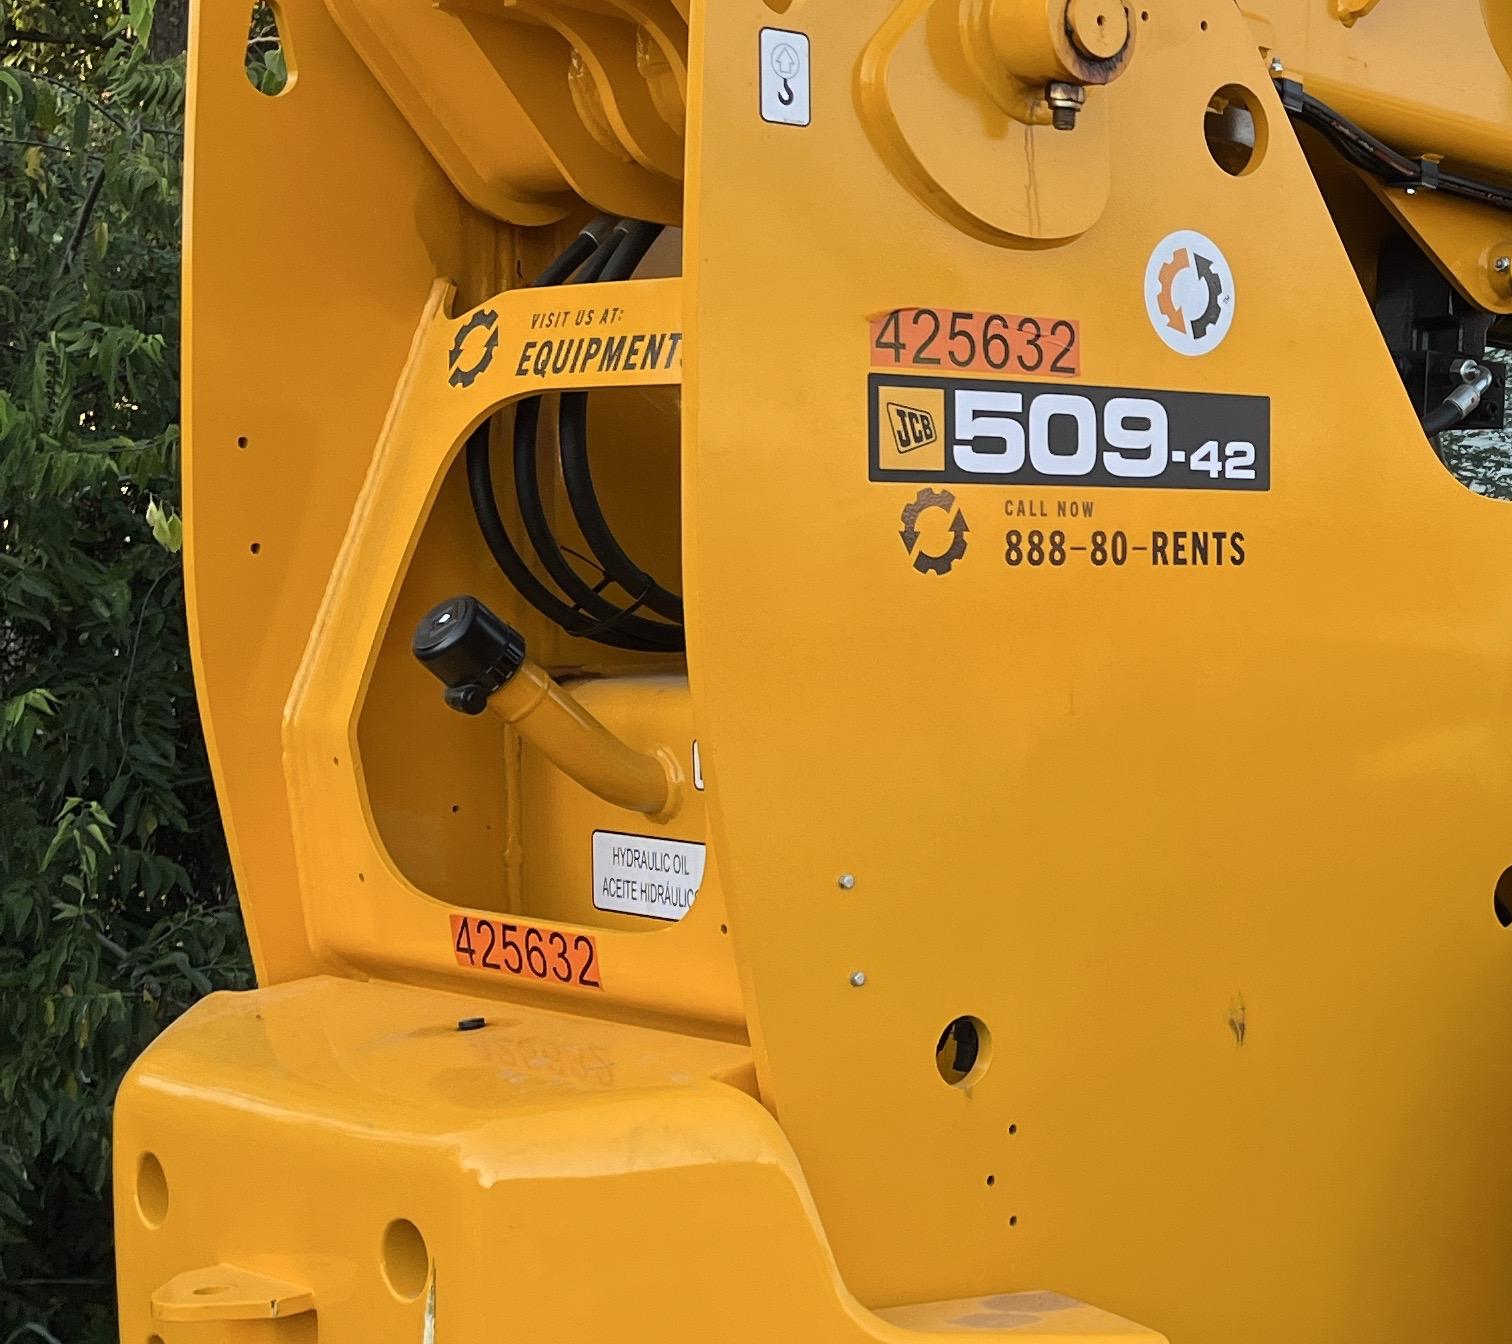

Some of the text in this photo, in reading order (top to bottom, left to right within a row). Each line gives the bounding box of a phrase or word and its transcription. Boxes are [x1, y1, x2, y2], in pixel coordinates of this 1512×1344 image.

[531, 307, 624, 329] VISIT US AT:
[515, 333, 682, 378] EQUIPMENT
[874, 308, 1077, 375] 425632
[897, 389, 1256, 480] JCB 509-42
[1004, 499, 1094, 518] CALL NOW
[1005, 529, 1246, 567] 888-80-RENTS
[612, 846, 690, 875] HYDRAULIC OIL
[602, 877, 699, 908] ACEITE HIDRÁULIC
[456, 917, 600, 988] 425632
